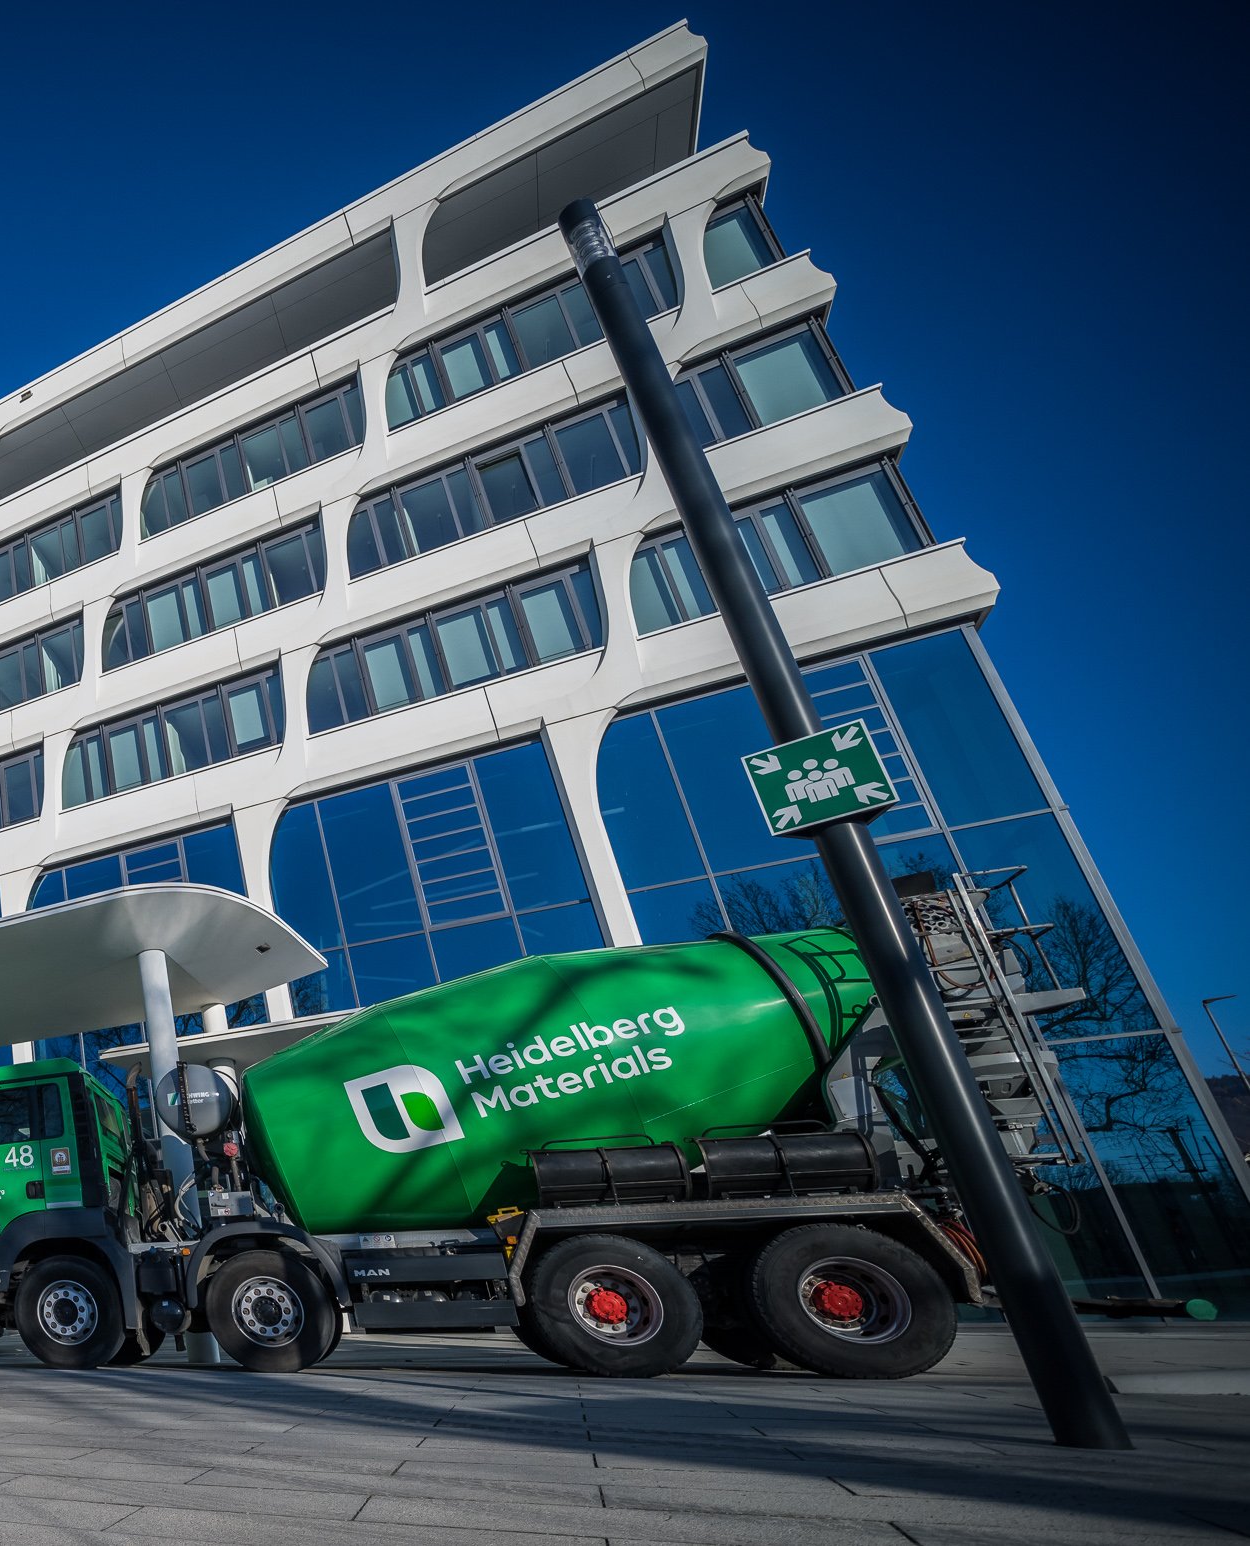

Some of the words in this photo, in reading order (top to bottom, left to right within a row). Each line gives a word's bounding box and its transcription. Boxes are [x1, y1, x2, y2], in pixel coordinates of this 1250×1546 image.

[454, 1006, 686, 1084] Heidelberg
[470, 1045, 673, 1118] Materials
[4, 1145, 34, 1167] 48
[354, 1268, 391, 1277] MAN
